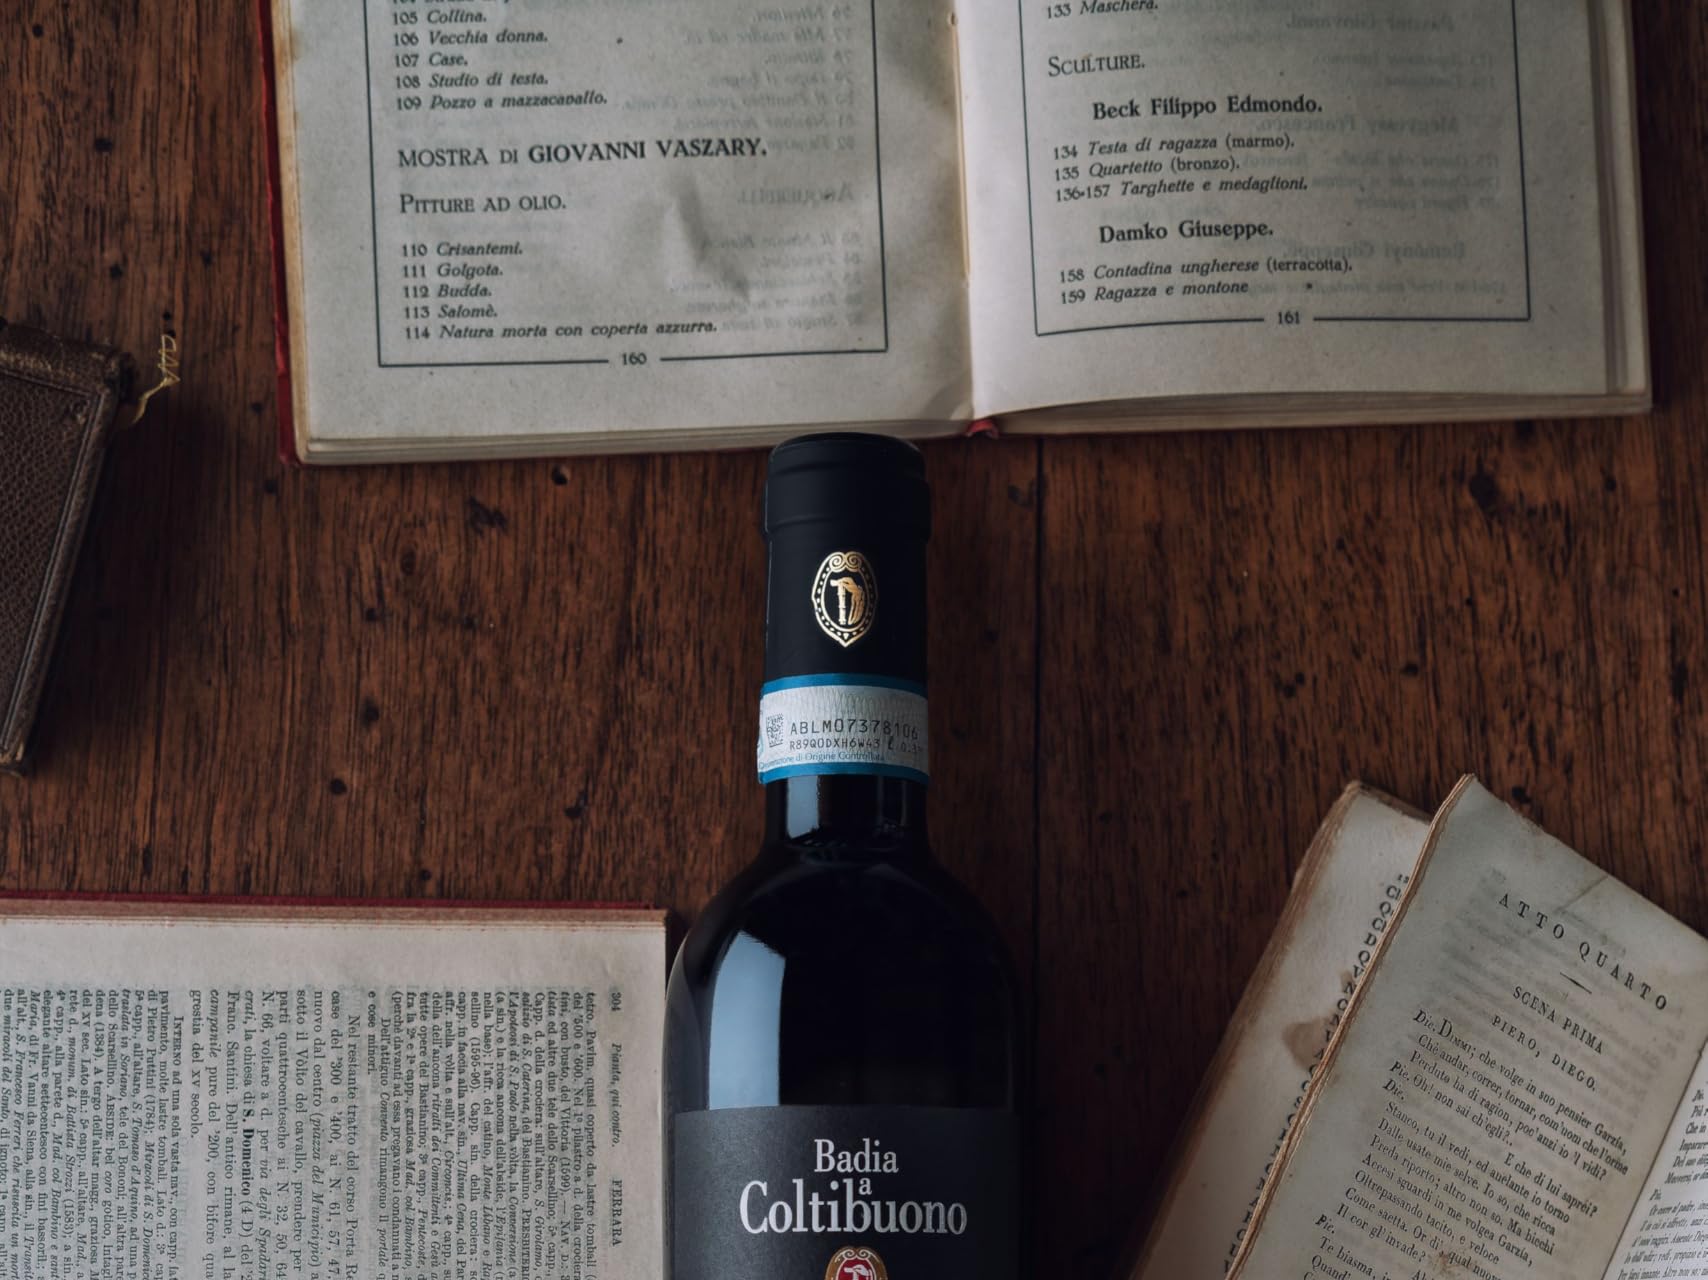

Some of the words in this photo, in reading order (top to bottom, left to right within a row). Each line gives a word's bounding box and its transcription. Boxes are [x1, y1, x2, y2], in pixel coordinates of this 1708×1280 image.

[393, 11, 418, 25] 105
[427, 9, 487, 24] Collina.
[1047, 3, 1071, 19] 133
[1080, 0, 1158, 15] Maschera.
[394, 32, 419, 46] 106
[429, 30, 488, 45] Vecchia
[496, 28, 548, 43] donna.
[395, 53, 419, 67] 107
[429, 52, 468, 66] Case.
[396, 75, 420, 89] 108
[429, 74, 479, 88] Studio
[487, 73, 502, 86] di
[510, 73, 548, 85] testa.
[397, 96, 422, 110] 109
[430, 95, 476, 109] Pozzo
[484, 98, 493, 108] a
[1093, 99, 1140, 120] Beck
[1151, 97, 1216, 118] Filippo
[1227, 94, 1322, 113] Edmondo.
[398, 148, 489, 167] MOSTRA
[500, 149, 518, 164] DI
[528, 141, 645, 163] GIOVANNI
[656, 138, 767, 158] VASZARY.
[1054, 145, 1078, 160] 134
[1089, 141, 1128, 156] Testa
[1135, 137, 1151, 152] di
[1158, 138, 1217, 154] ragazza
[1225, 133, 1294, 152] (marmo).
[1056, 166, 1079, 181] 135
[1089, 160, 1162, 178] Quartetto
[1170, 155, 1239, 174] (bronzo).
[1121, 179, 1194, 198] Targhette
[1202, 181, 1211, 191] e
[1219, 176, 1307, 194] medaglioni.
[483, 197, 510, 212] AD
[519, 195, 566, 211] OLIO.
[1099, 222, 1168, 243] Damko
[1178, 220, 1273, 240] Giuseppe.
[403, 244, 427, 257] 110
[436, 242, 522, 256] Crisantemi.
[403, 265, 425, 278] 111
[437, 262, 503, 281] Golgota.
[1061, 268, 1085, 283] 158
[1094, 261, 1172, 279] Contadina
[1181, 259, 1259, 276] ungherese
[1266, 256, 1352, 274] (terracotta).
[404, 285, 429, 298] 112
[437, 283, 492, 297] Budda.
[1061, 289, 1085, 304] 159
[1094, 286, 1157, 303] Ragazza
[1165, 286, 1174, 295] e
[1182, 281, 1248, 295] montone
[405, 306, 430, 319] 113
[438, 304, 497, 318] Salomè.
[1278, 311, 1300, 324] 161
[406, 326, 430, 339] 114
[439, 324, 493, 338] Natura
[501, 325, 547, 338] morta
[555, 326, 582, 336] con
[591, 323, 648, 338] coperta
[656, 322, 717, 334] azzurra.
[622, 352, 647, 365] 160
[1499, 894, 1564, 939] ATTO
[1579, 942, 1667, 1010] QUARTO
[1513, 986, 1555, 1023] SCENA
[1562, 1017, 1602, 1054] PRIMA
[610, 1044, 622, 1084] Pianta,
[1491, 1015, 1540, 1058] PIERO,
[1552, 1054, 1595, 1091] DIEGO.
[610, 1089, 622, 1108] qui
[1479, 1051, 1496, 1069] che
[1500, 1065, 1524, 1086] volge
[1526, 1082, 1536, 1095] in
[1539, 1091, 1555, 1106] suo
[1556, 1103, 1592, 1128] pensier
[612, 1110, 621, 1147] contro.
[814, 1138, 899, 1173] Badia
[859, 1178, 872, 1195] a
[612, 1180, 622, 1246] FERRARA
[740, 1178, 967, 1234] Coltibuono
